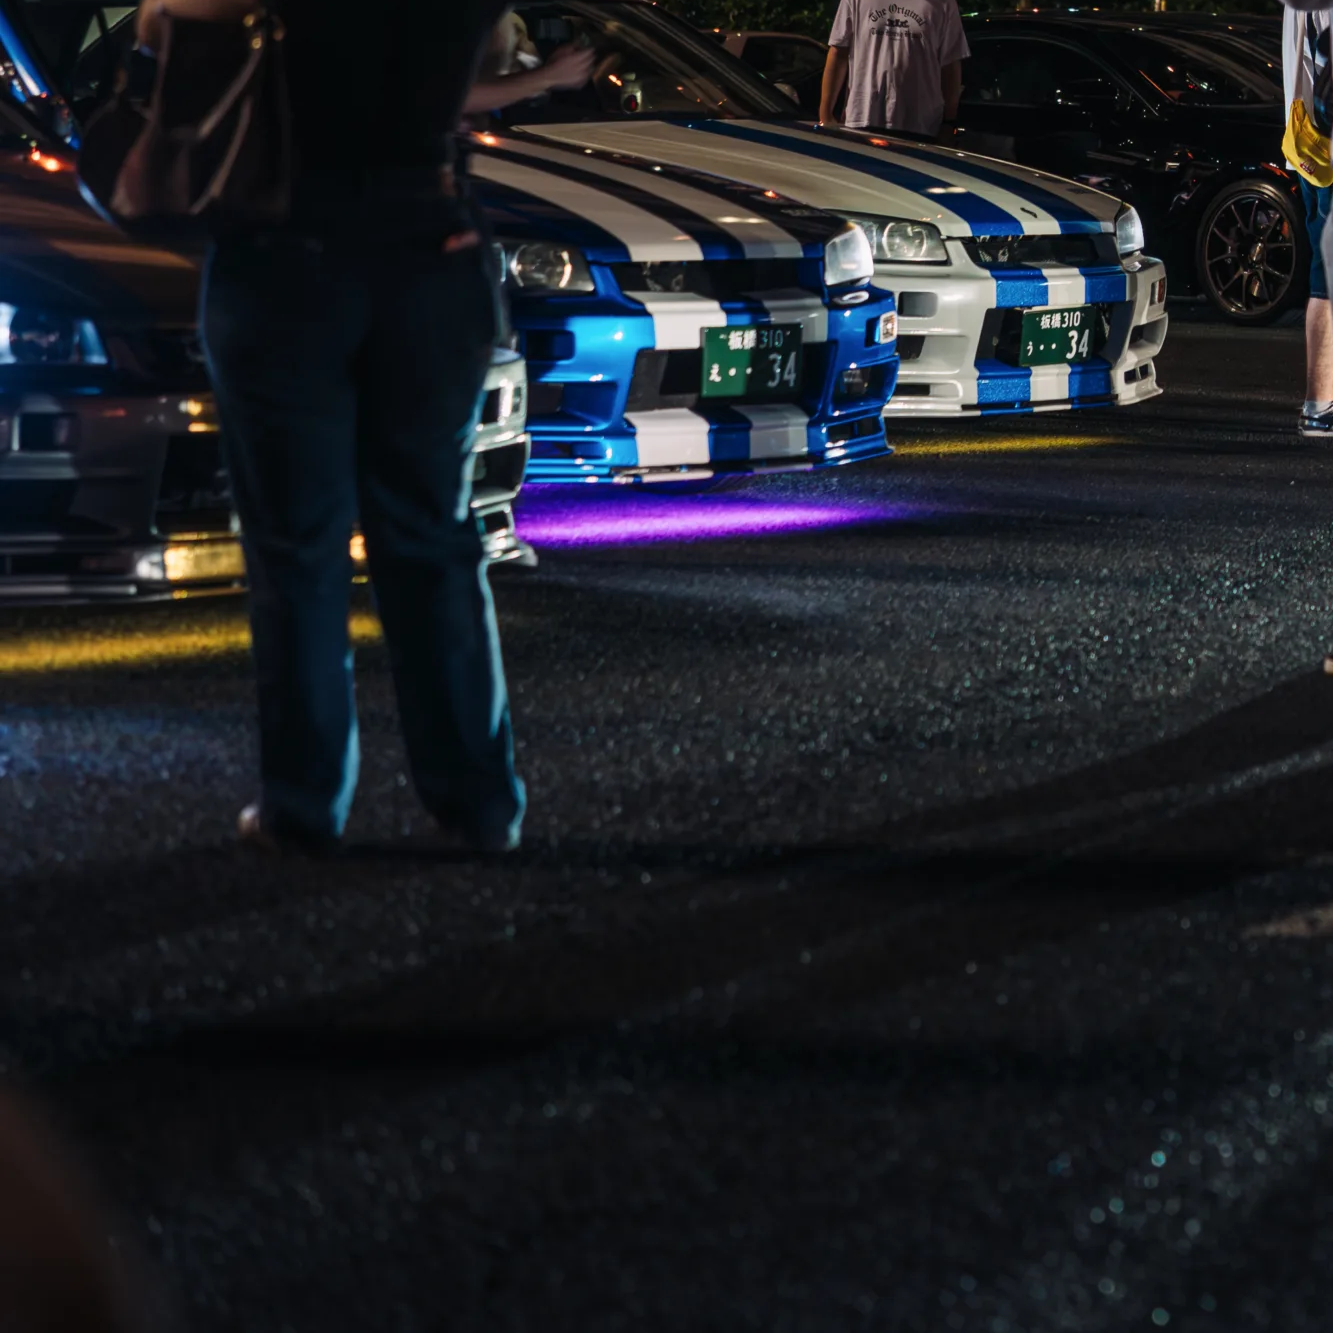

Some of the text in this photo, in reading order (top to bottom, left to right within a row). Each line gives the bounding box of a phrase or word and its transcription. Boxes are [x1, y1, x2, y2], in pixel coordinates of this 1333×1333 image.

[868, 3, 926, 27] The Original
[1040, 310, 1081, 330] 板橋 310
[758, 329, 784, 349] 310
[1065, 329, 1090, 360] 34
[766, 351, 797, 388] 34
